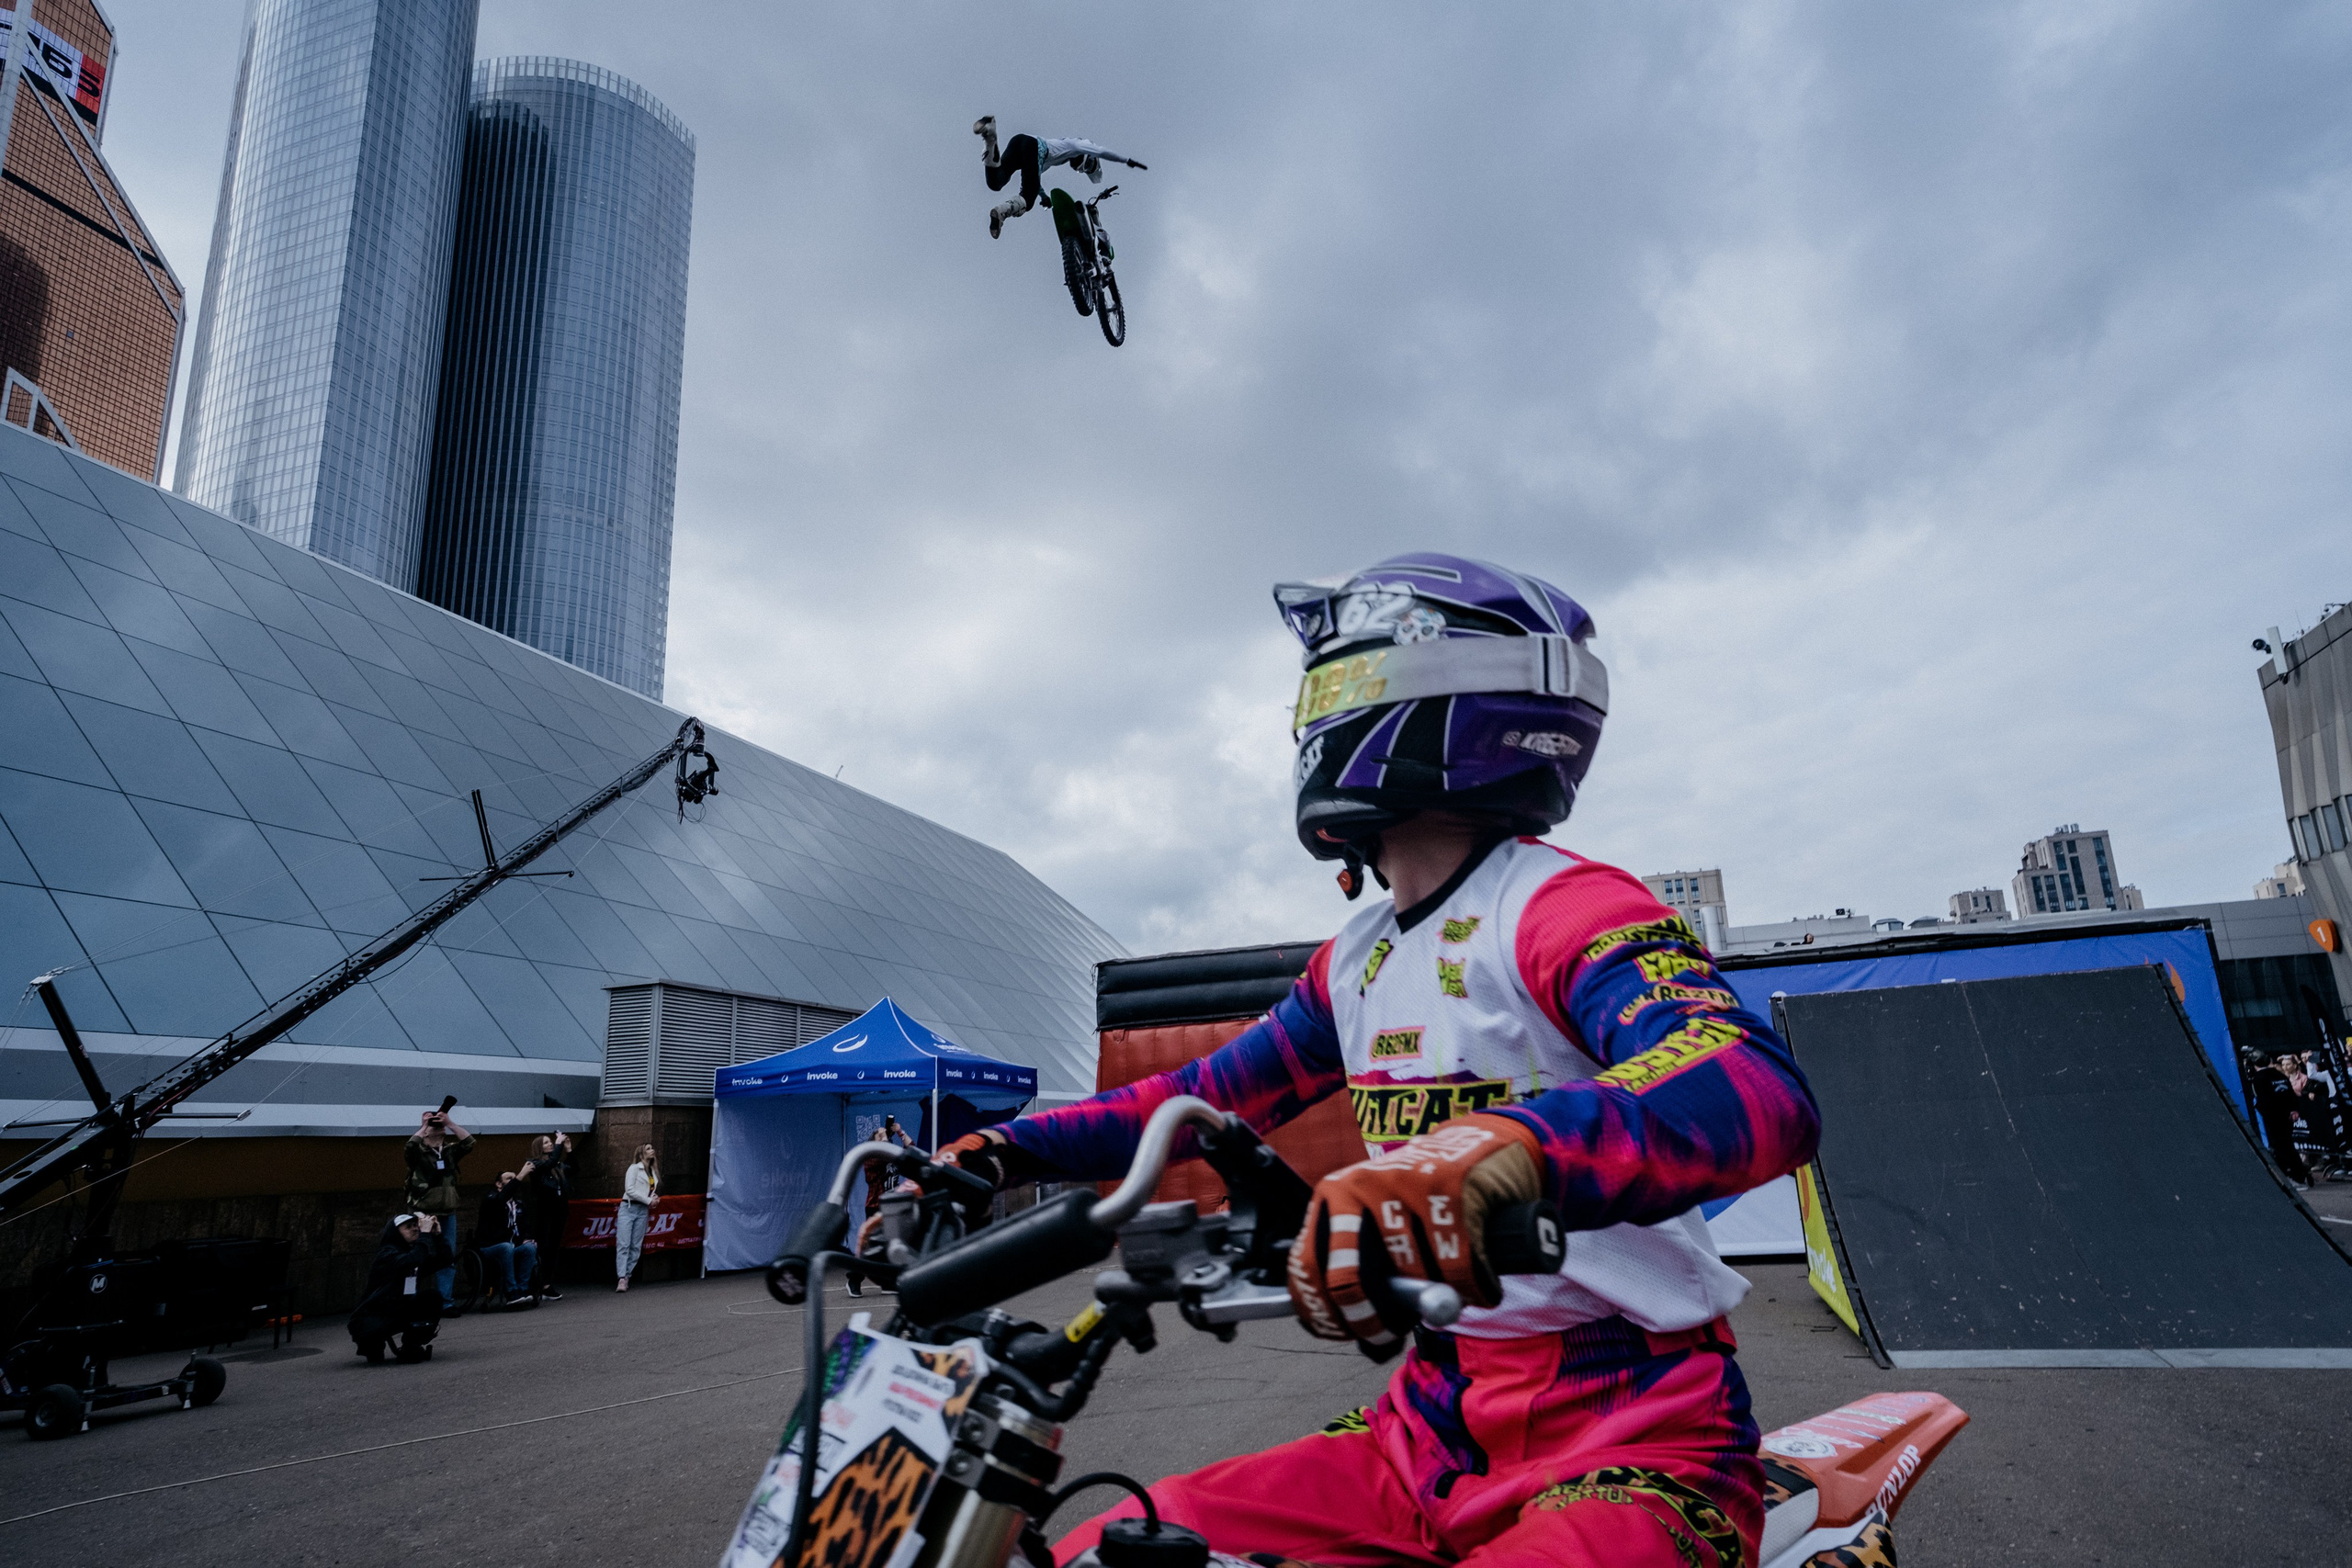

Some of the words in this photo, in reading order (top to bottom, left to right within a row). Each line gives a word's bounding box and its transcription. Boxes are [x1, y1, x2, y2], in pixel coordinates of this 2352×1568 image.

[2317, 926, 2326, 942] 1
[731, 1077, 763, 1086] invoke
[807, 1071, 838, 1080] invoke
[884, 1069, 916, 1078] invoke
[945, 1068, 963, 1077] invoke
[983, 1071, 999, 1080] invoke
[1018, 1076, 1031, 1084] invoke
